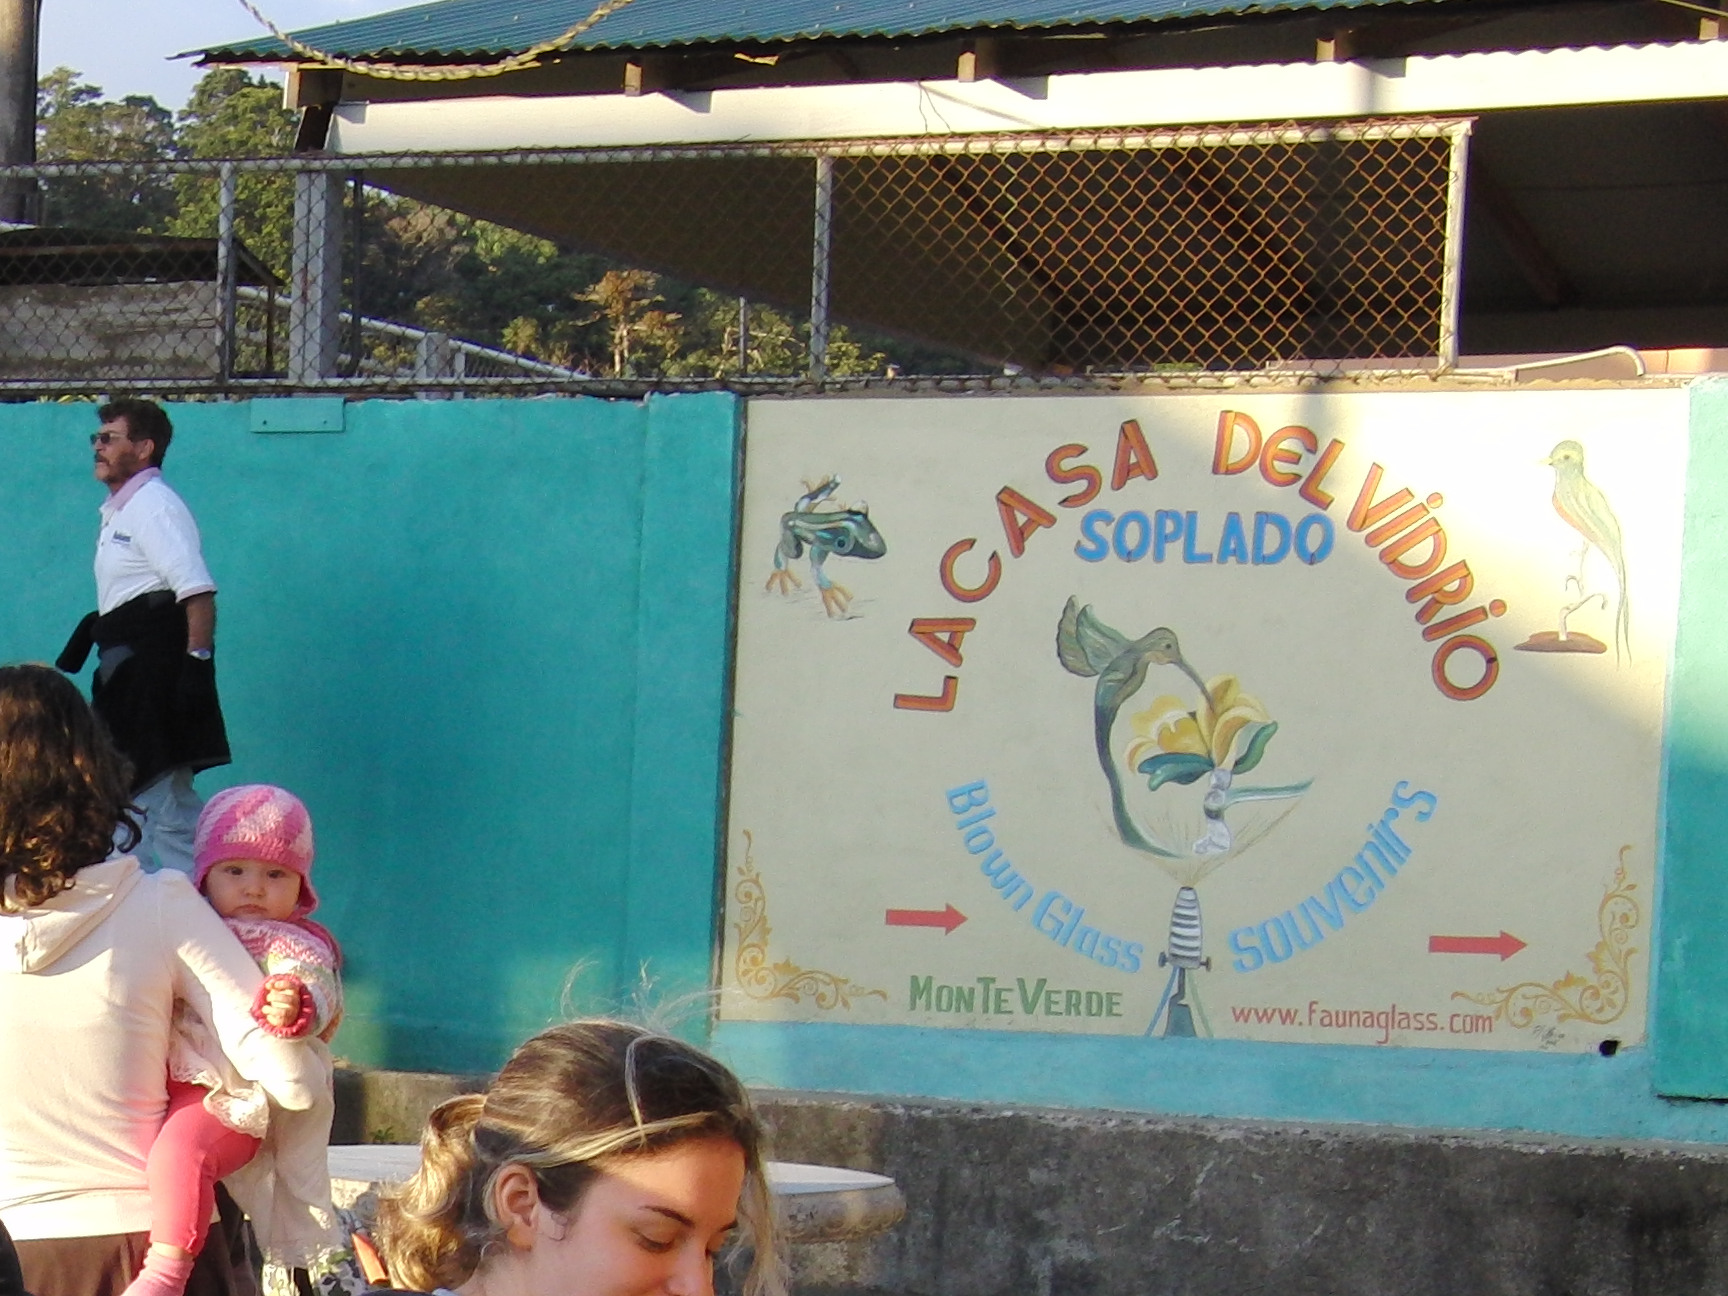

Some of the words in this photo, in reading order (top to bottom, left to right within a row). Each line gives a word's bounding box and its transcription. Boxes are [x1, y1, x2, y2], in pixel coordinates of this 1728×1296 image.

[893, 617, 977, 712] LA
[939, 418, 1159, 603] CASA
[1211, 409, 1346, 511] DEL
[1073, 508, 1336, 566] SOPLADO
[945, 778, 1035, 913] Blown
[1030, 889, 1145, 975] Glass
